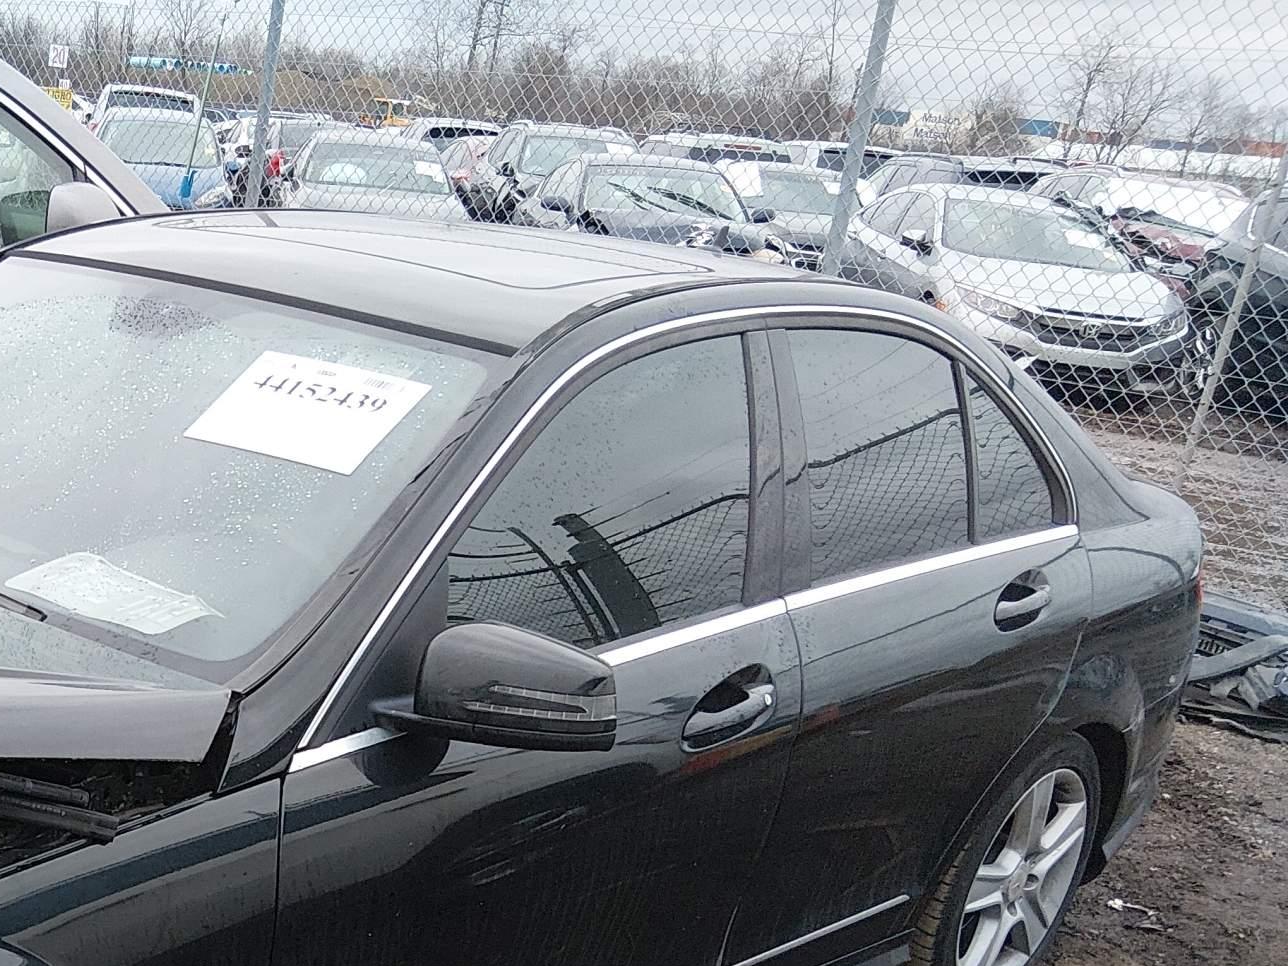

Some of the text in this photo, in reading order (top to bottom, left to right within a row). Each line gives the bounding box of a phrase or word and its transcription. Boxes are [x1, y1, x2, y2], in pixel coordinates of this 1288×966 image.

[52, 47, 66, 65] 20
[922, 112, 961, 124] Matson
[253, 374, 388, 412] 44152439
